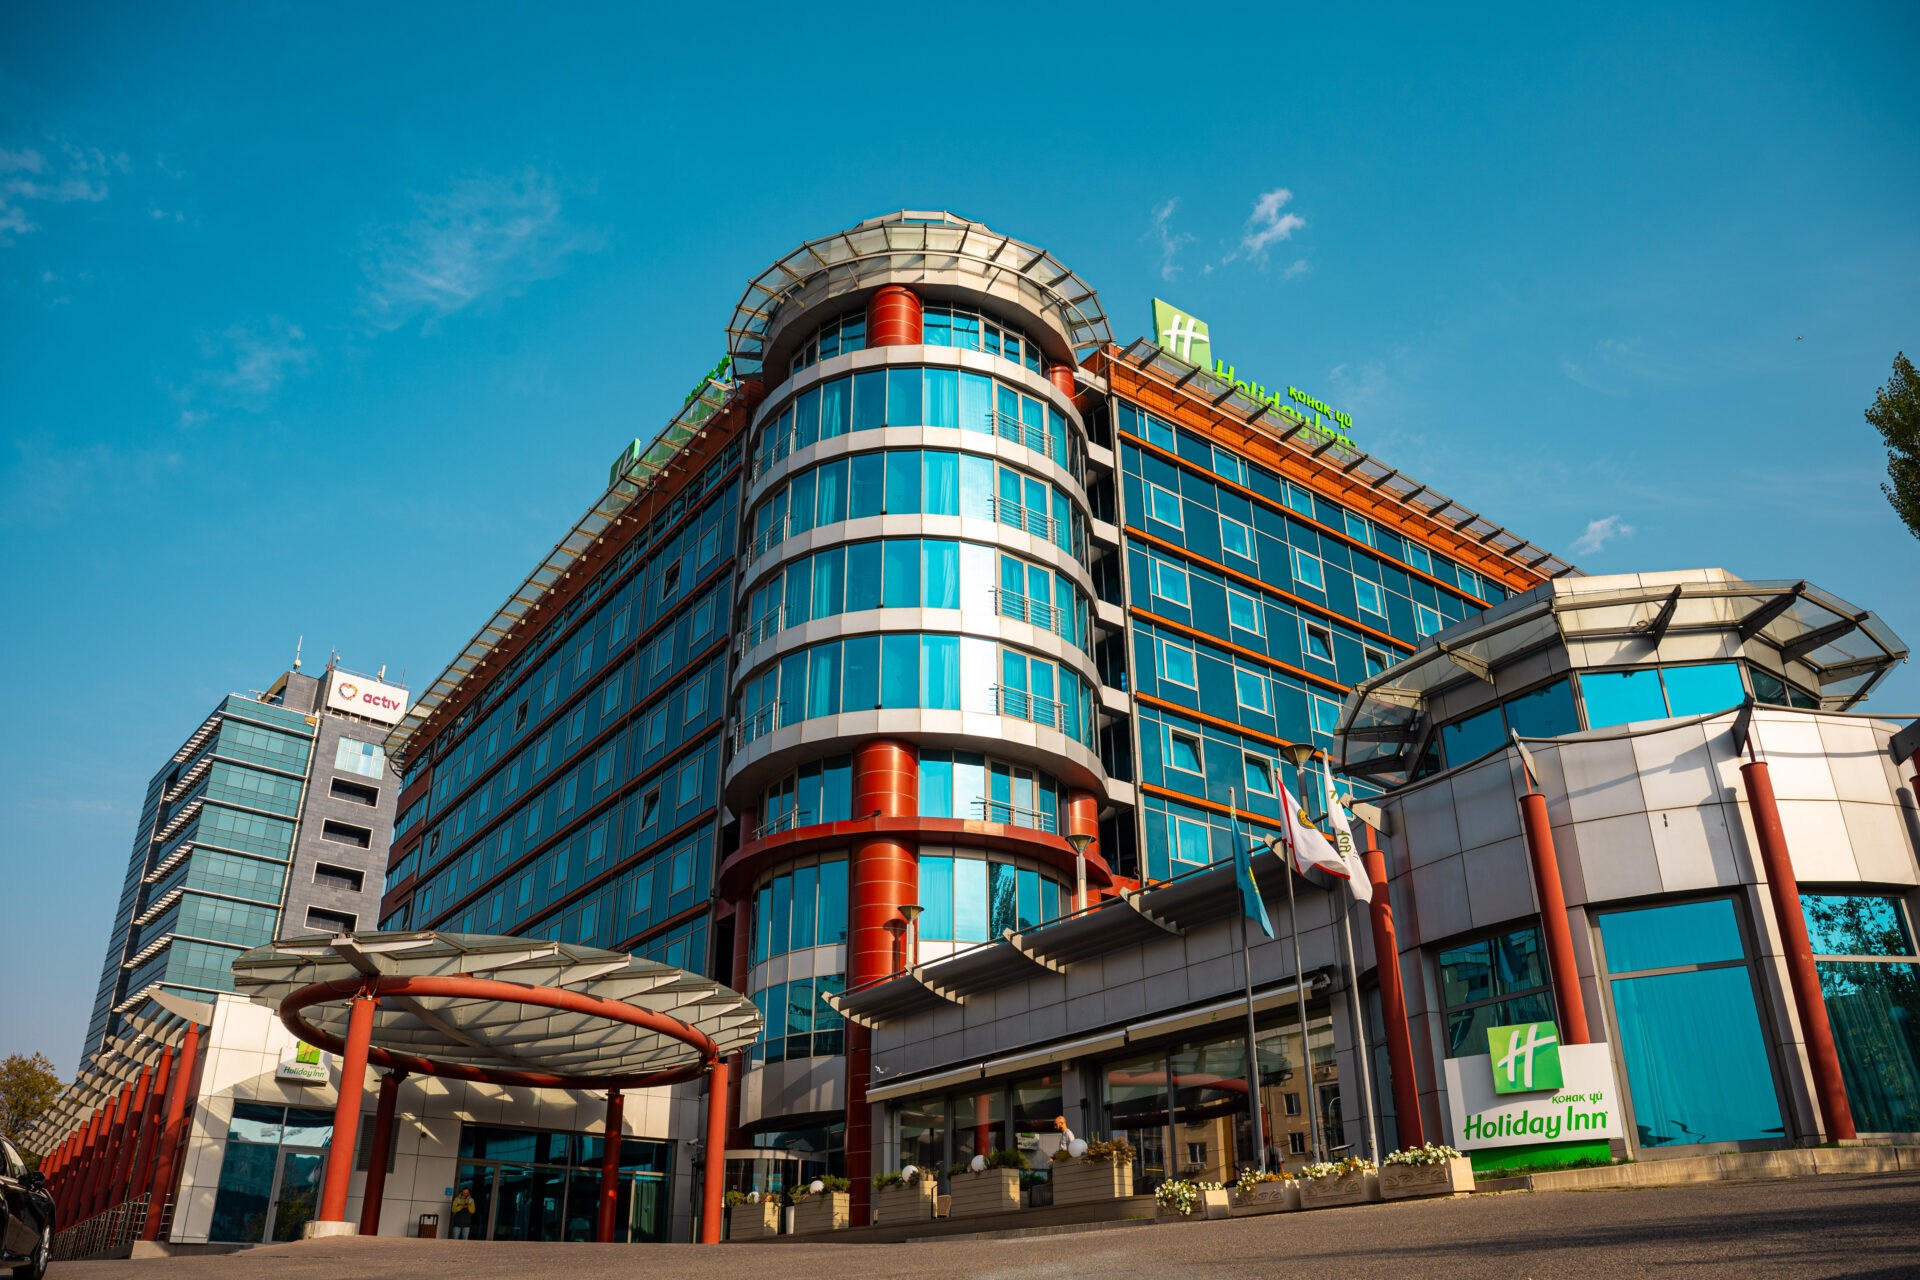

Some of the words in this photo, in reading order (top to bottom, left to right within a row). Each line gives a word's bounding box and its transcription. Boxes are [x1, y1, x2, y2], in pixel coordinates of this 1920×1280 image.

[1213, 359, 1311, 439] Holiday
[1314, 413, 1351, 455] Inn
[362, 693, 401, 711] activ
[283, 1065, 313, 1078] Holiday
[313, 1069, 325, 1078] Inn
[1463, 1110, 1561, 1140] Holiday
[1567, 1105, 1607, 1131] Inn
